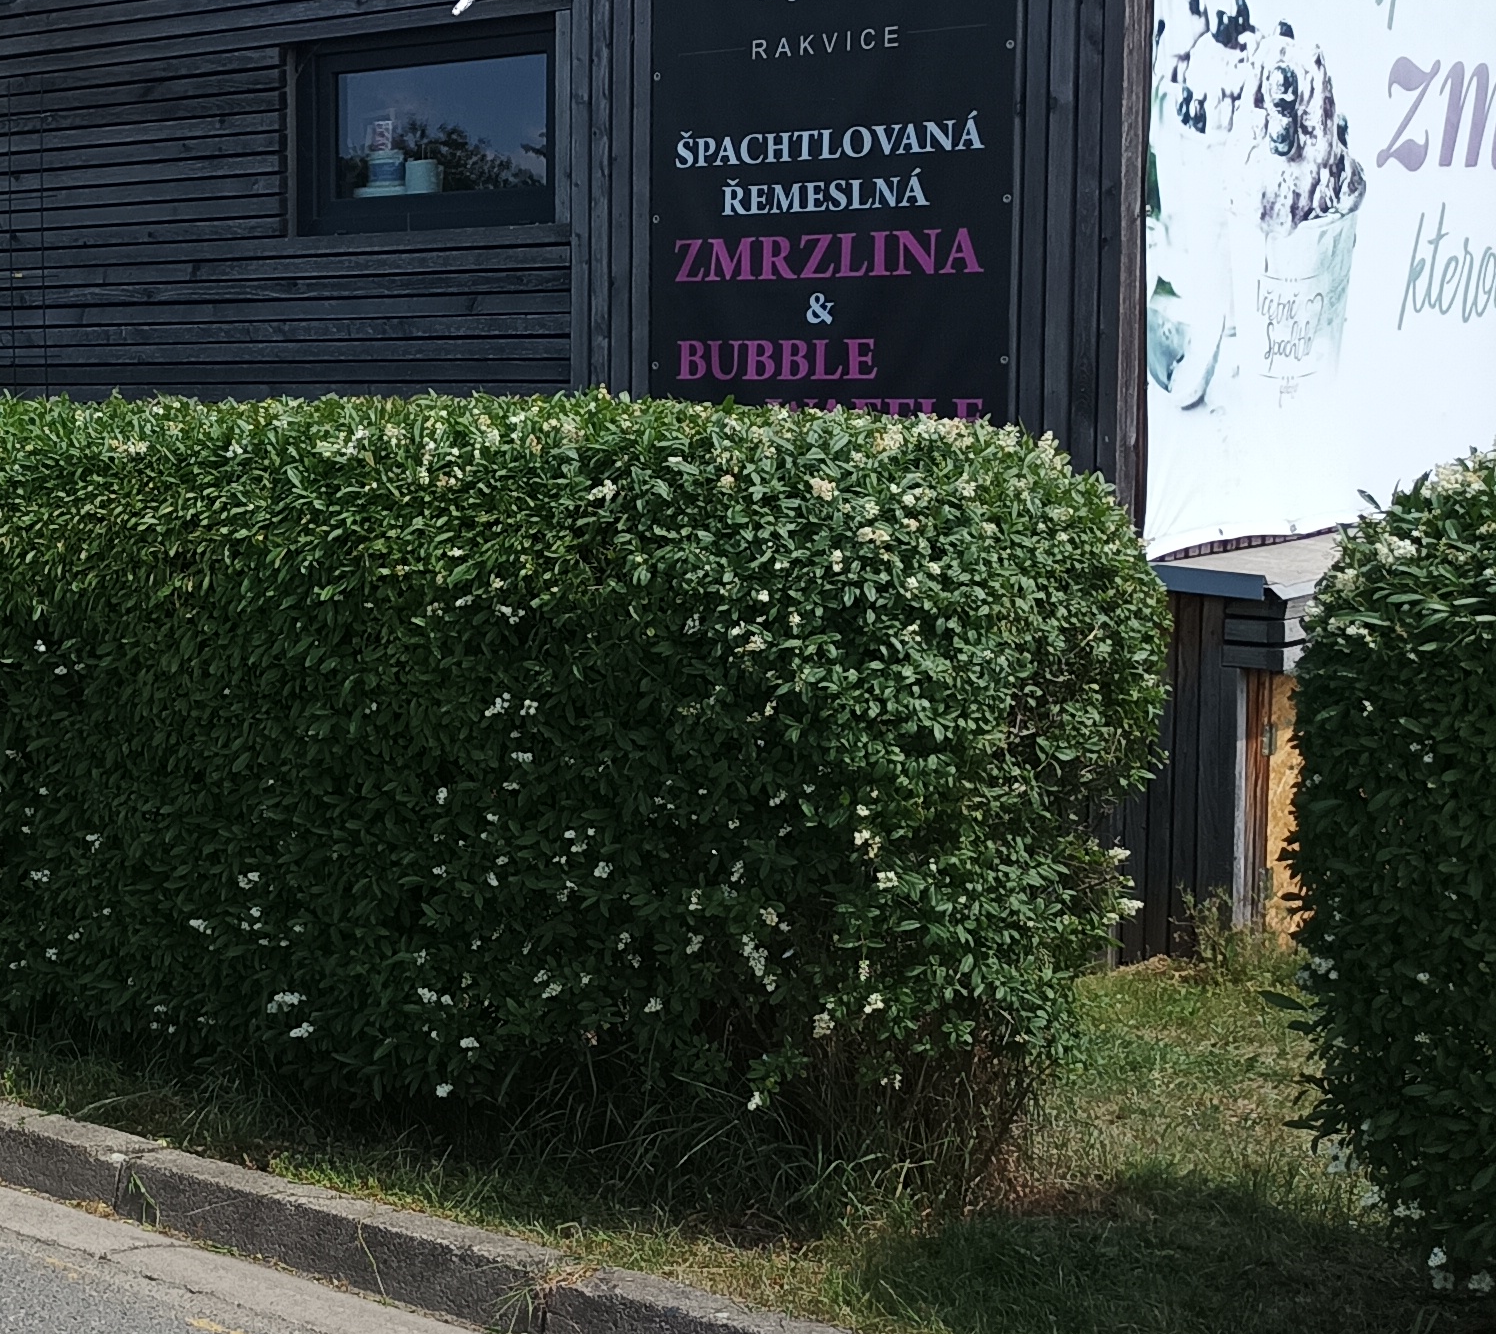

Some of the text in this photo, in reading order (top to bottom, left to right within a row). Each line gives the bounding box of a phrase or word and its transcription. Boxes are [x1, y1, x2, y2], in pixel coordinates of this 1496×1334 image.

[752, 26, 900, 60] RAKVICE
[675, 110, 985, 168] ŠPACHTLOVANÁ
[721, 167, 930, 216] ŘEMESLNÁ
[674, 227, 984, 283] ZMRZLINA
[806, 292, 834, 324] &
[676, 338, 878, 381] BUBBLE
